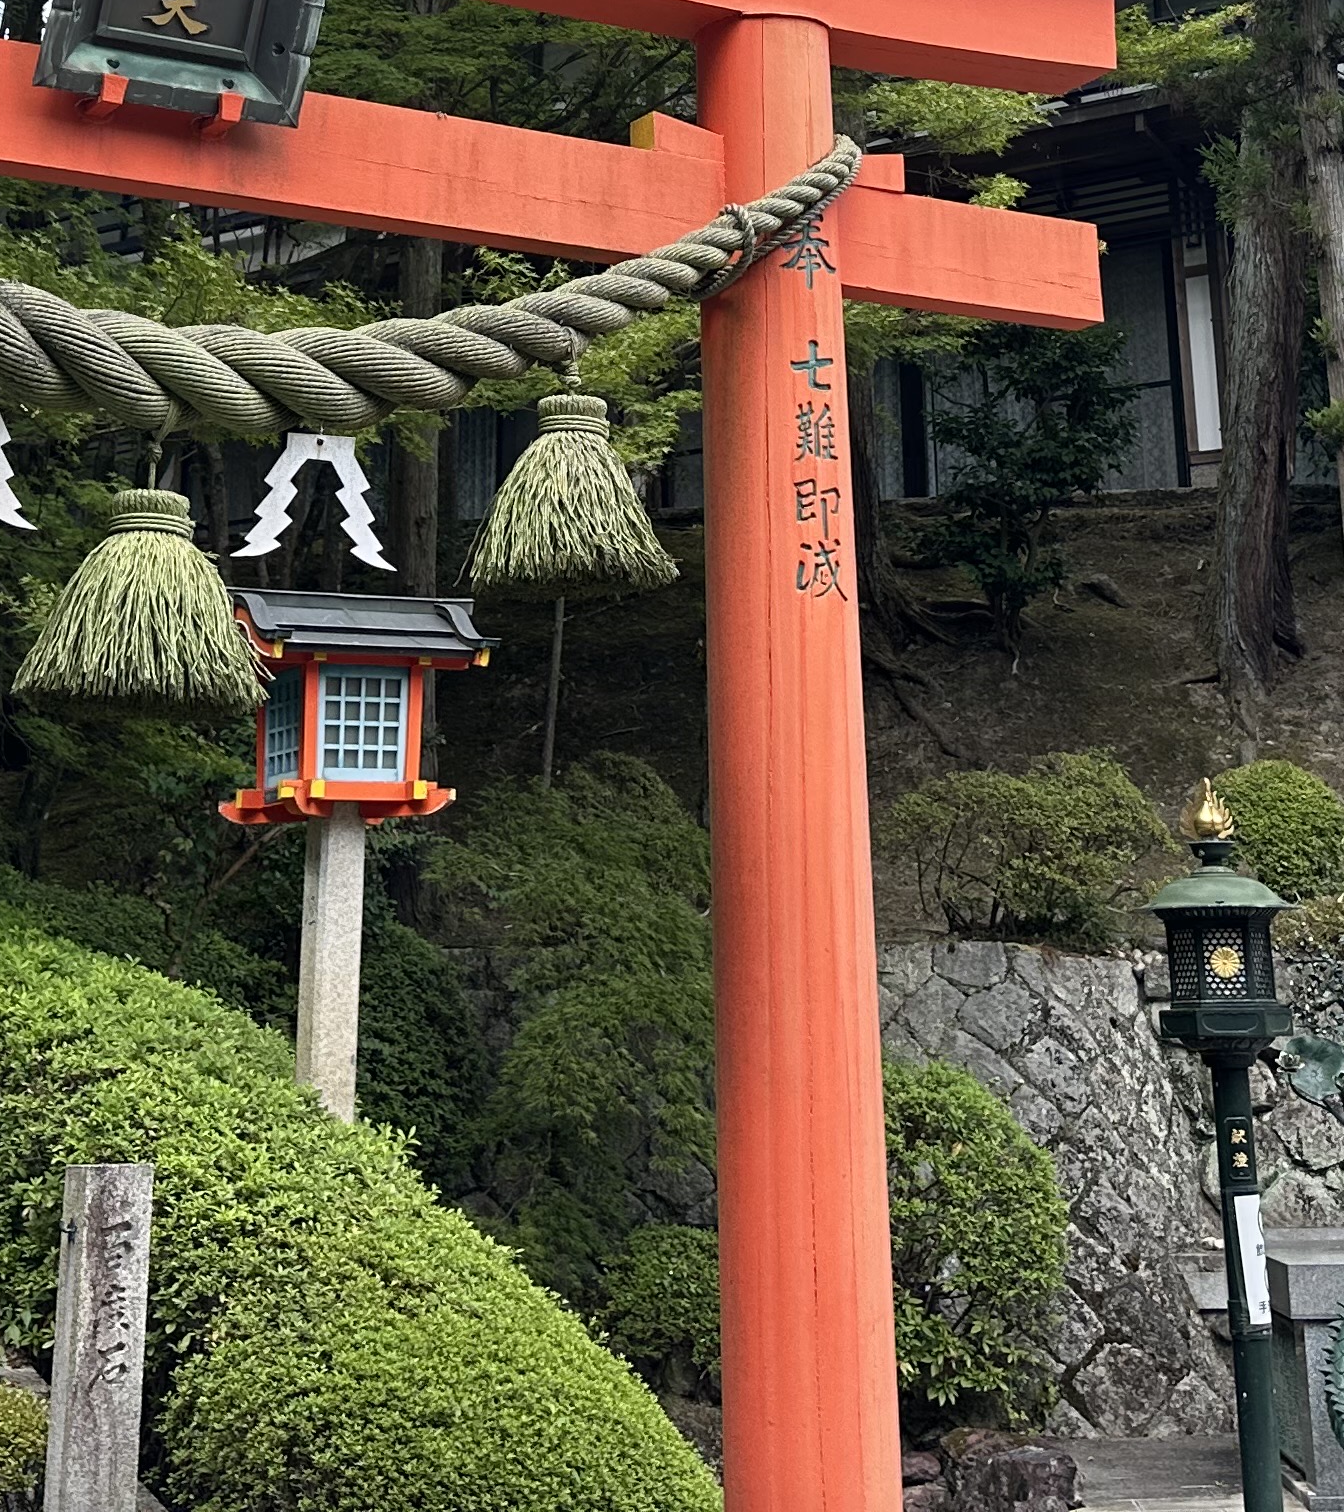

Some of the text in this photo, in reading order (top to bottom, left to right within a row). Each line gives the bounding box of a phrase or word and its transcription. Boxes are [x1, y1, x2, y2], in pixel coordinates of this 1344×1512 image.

[781, 213, 848, 601] 奉 七難即滅
